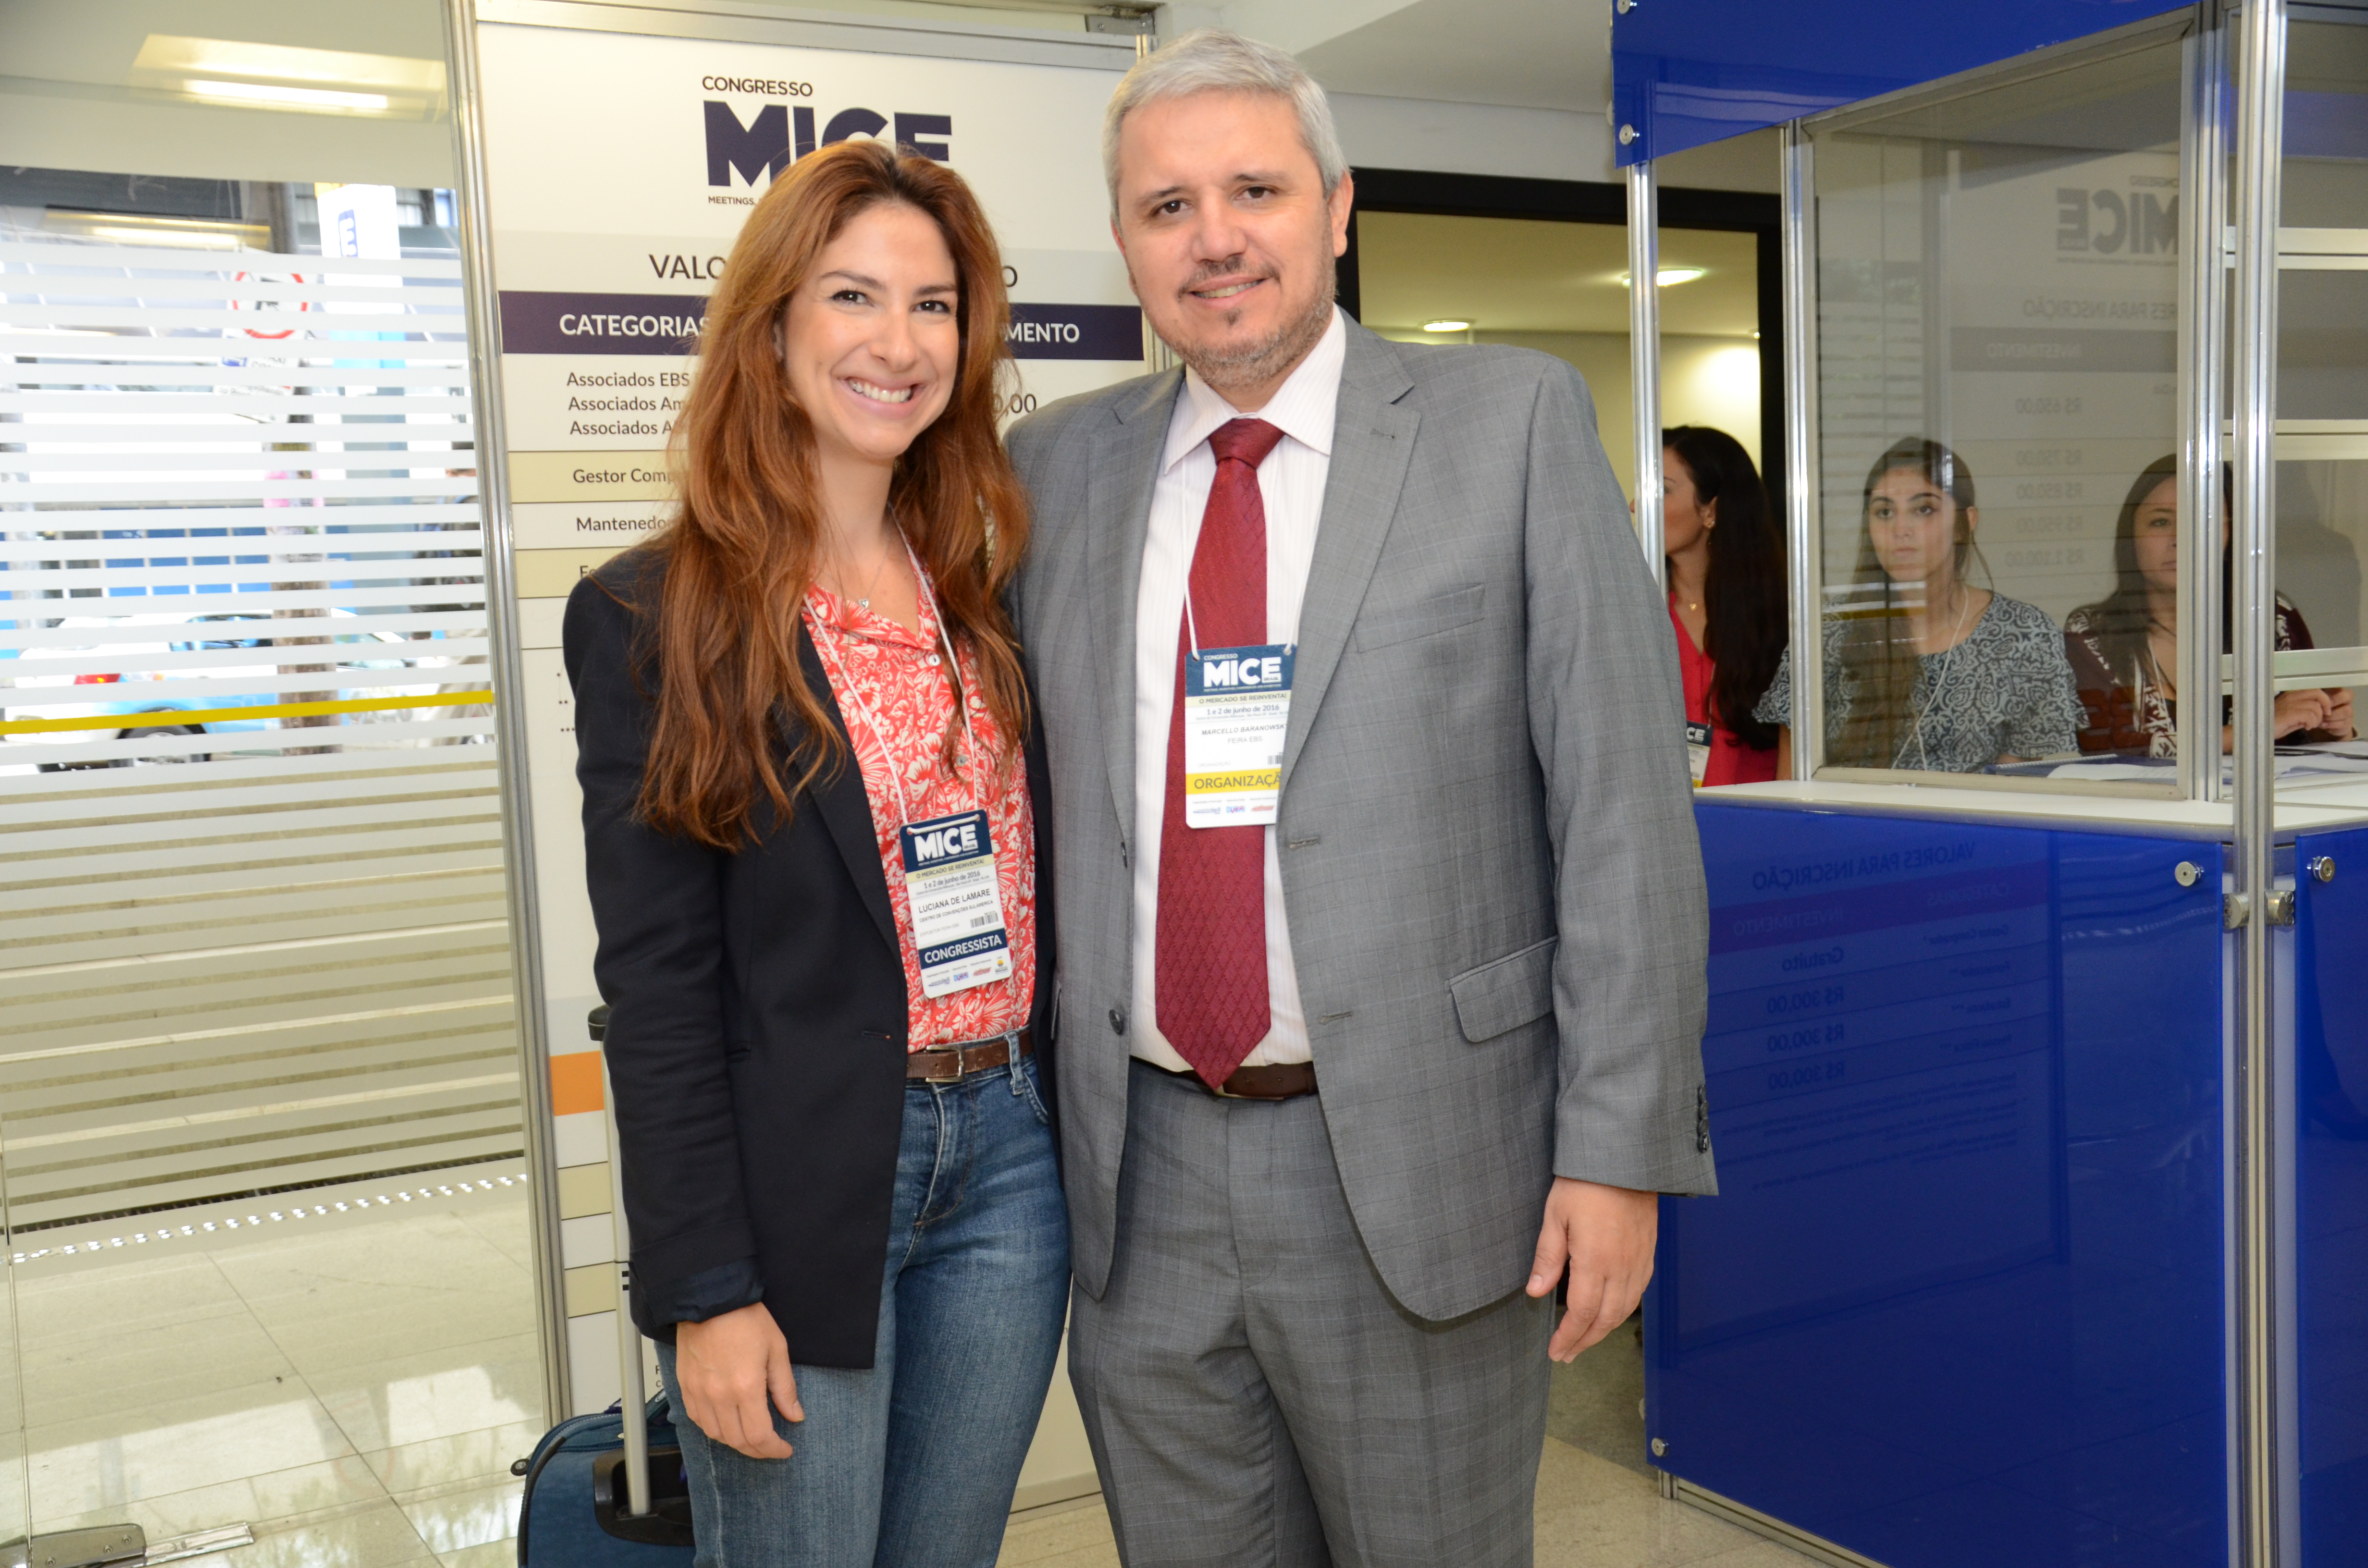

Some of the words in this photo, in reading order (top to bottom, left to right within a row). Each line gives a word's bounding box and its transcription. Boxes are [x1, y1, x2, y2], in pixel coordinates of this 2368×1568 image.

[702, 75, 813, 97] CONGRESSO
[649, 254, 726, 279] VALO
[567, 372, 654, 387] Associados
[660, 373, 690, 387] EBS
[568, 397, 656, 411] Associados
[570, 421, 657, 435] Associados
[573, 469, 626, 483] Gestor
[577, 516, 669, 531] Mantenedo
[1204, 657, 1282, 687] MICE
[1233, 706, 1251, 714] junho
[1201, 727, 1238, 735] MARCELLO
[1687, 727, 1705, 741] CE
[1194, 771, 1282, 789] ORGANIZAÇÃ
[914, 823, 978, 862] MICE
[922, 867, 947, 877] MERCADO
[955, 858, 984, 869] REINVENTA!
[944, 875, 959, 885] junho
[967, 870, 980, 879] 2016
[918, 899, 950, 913] LUCIANA
[950, 896, 961, 905] DE
[962, 888, 990, 902] LAMARE
[942, 905, 969, 917] CONVENÇÕES
[924, 934, 1002, 964] CONGRESSISTA
